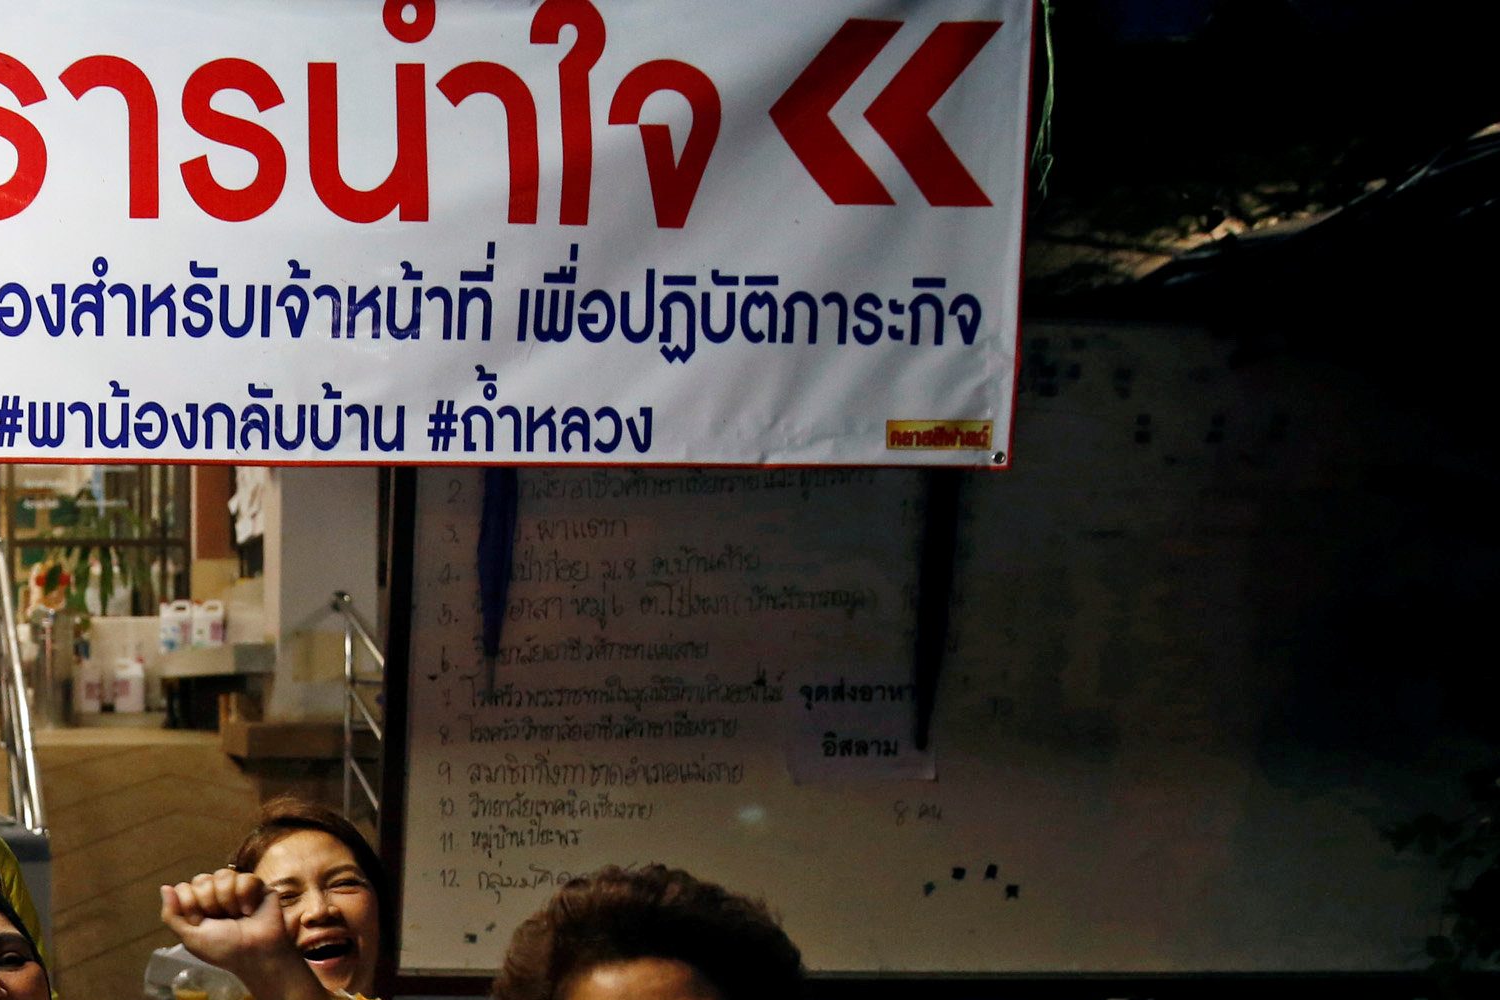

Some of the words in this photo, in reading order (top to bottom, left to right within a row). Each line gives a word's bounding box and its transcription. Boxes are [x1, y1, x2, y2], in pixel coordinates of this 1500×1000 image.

[516, 244, 983, 364] เพื่อปฏิบัติภาระกิจ
[428, 364, 653, 453] #ถ้ำหลวง
[799, 676, 916, 710] จุดส่งอาหา
[821, 730, 898, 757] อิสลาม
